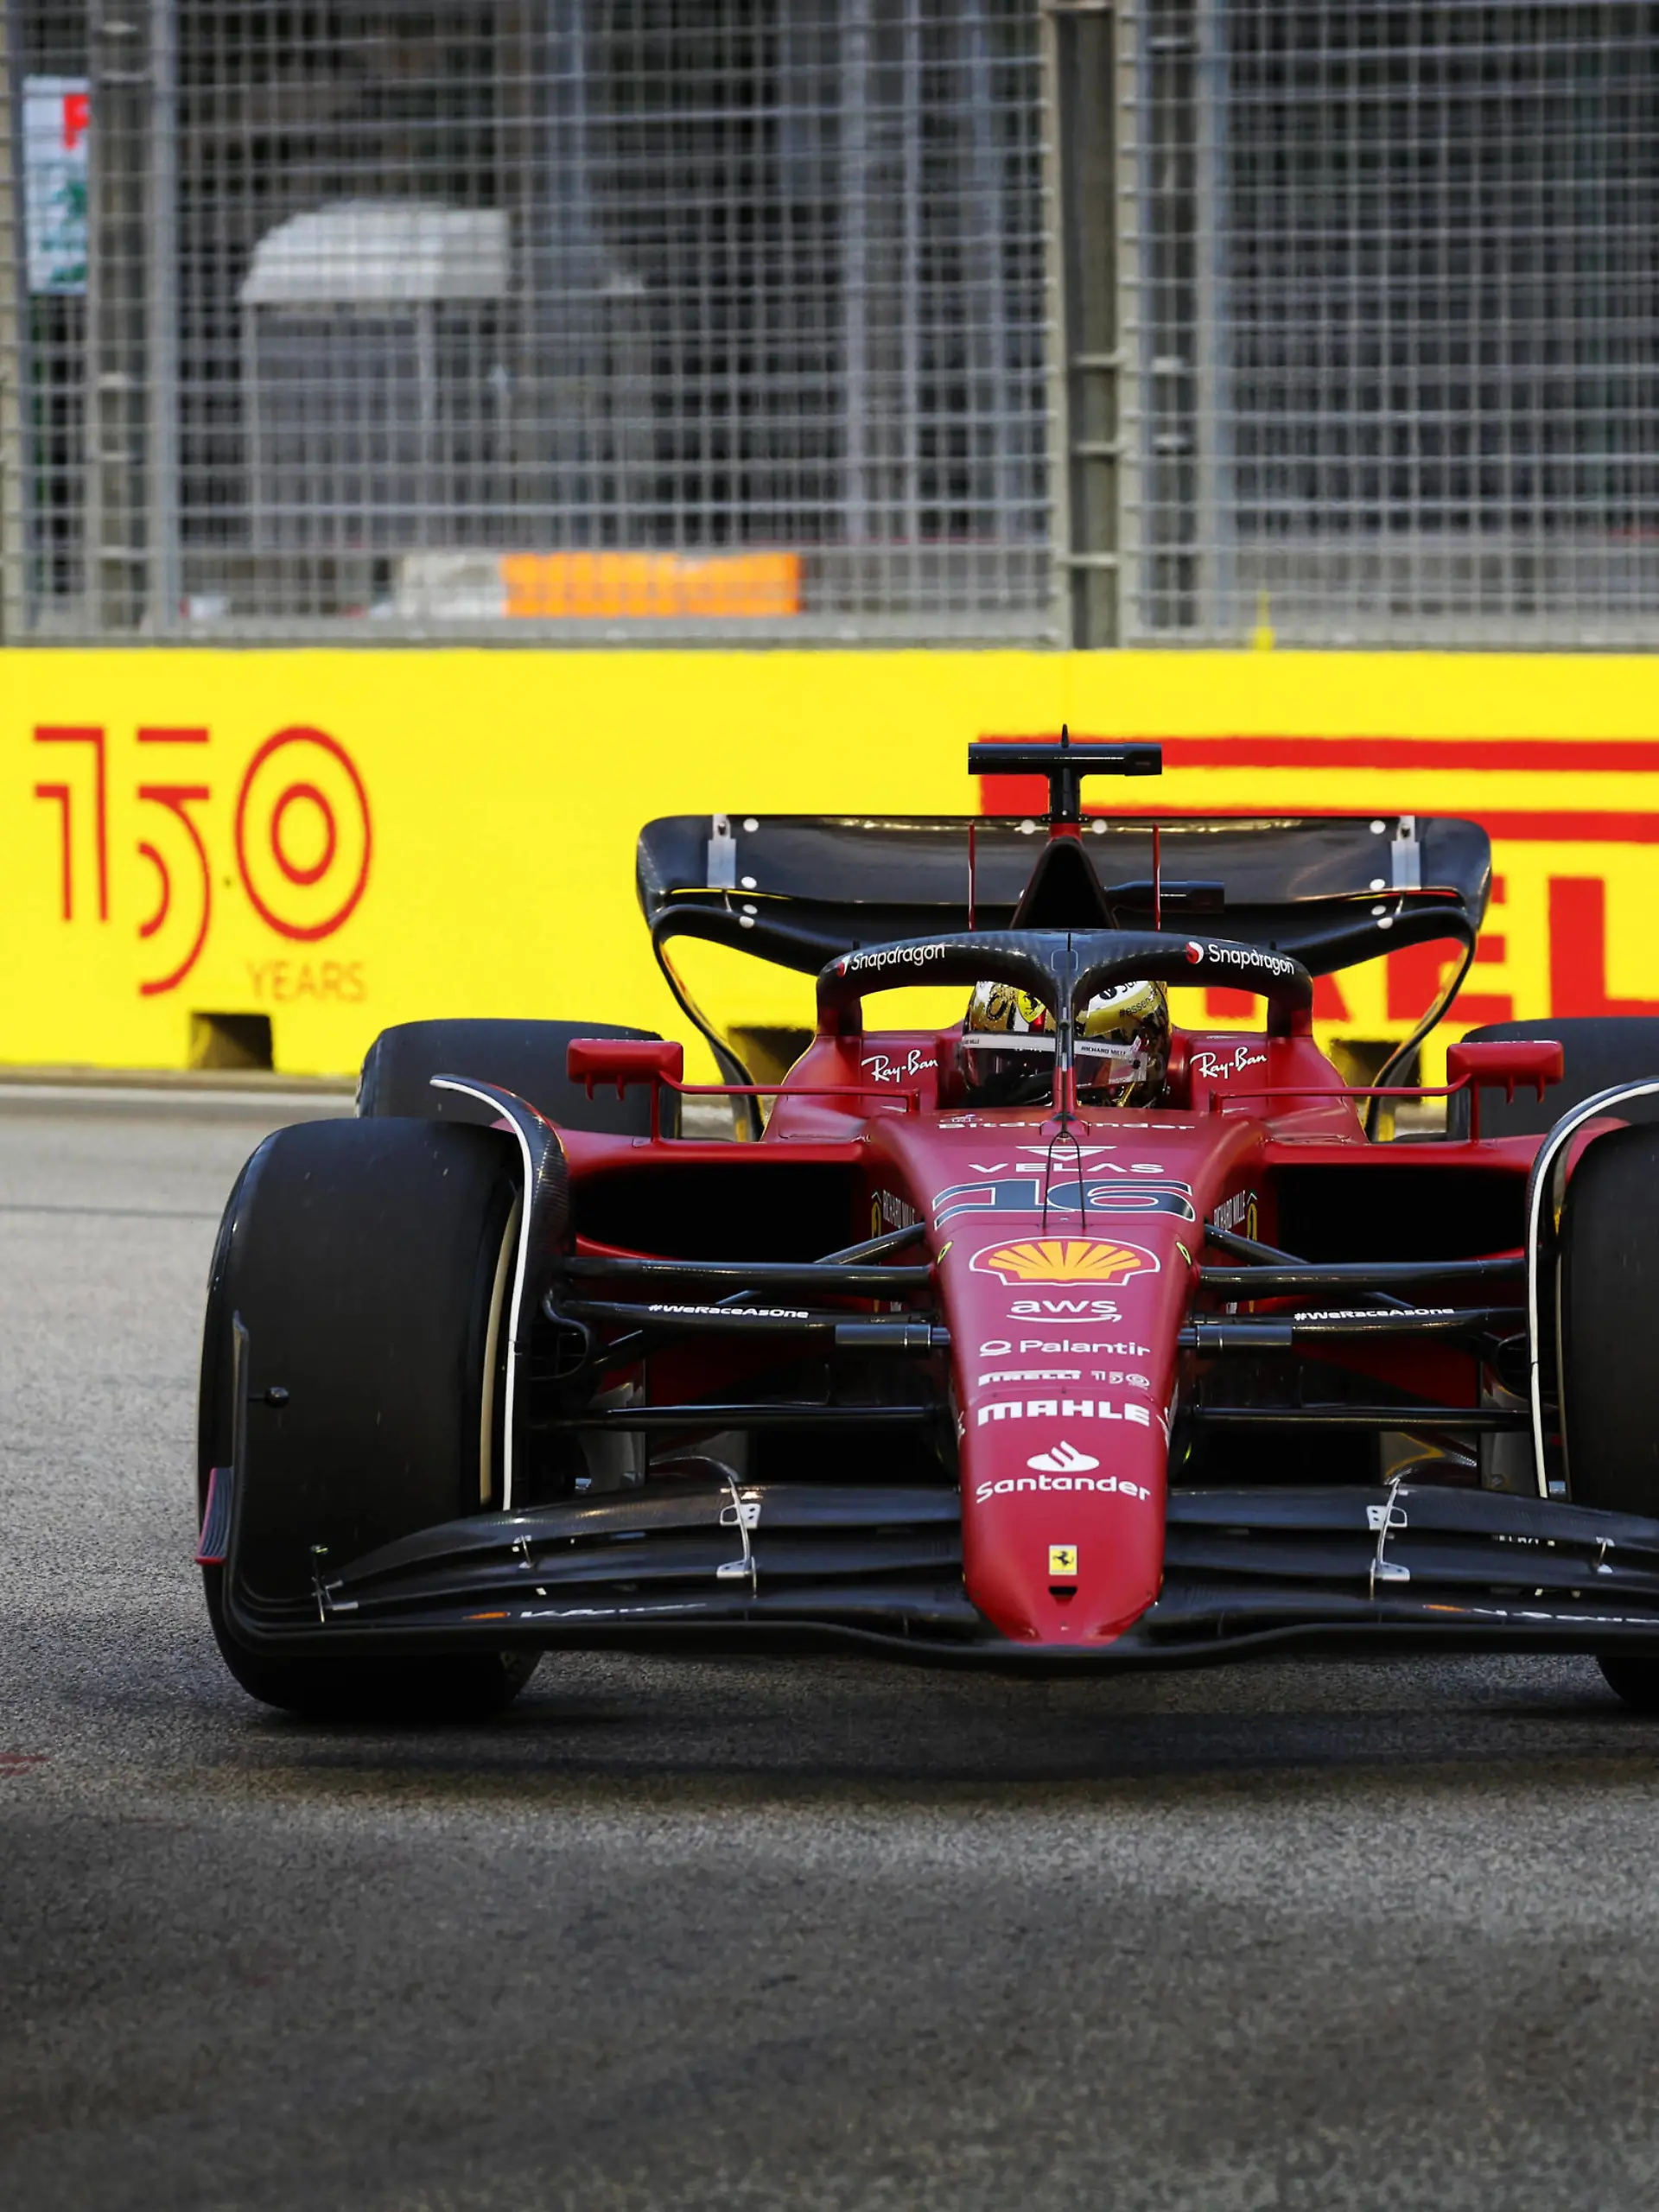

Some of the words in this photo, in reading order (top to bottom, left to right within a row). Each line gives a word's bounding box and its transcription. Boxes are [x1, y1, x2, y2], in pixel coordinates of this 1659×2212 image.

[34, 724, 372, 996] 150
[850, 943, 946, 970] Snapdragon
[1208, 944, 1295, 976] Snapdragon
[247, 960, 367, 1002] YEARS
[861, 1050, 938, 1083] Ray-Ban
[1189, 1046, 1267, 1079] Ray-Ban
[969, 1162, 1165, 1173] VELAS
[932, 1179, 1196, 1231] 16
[648, 1304, 810, 1319] #WeRaceAsOne
[1010, 1300, 1118, 1313] aws
[1294, 1308, 1455, 1321] #WeRaceAsOne
[1020, 1339, 1151, 1357] Palantir
[977, 1400, 1150, 1427] MAHLE
[976, 1474, 1151, 1504] Santander
